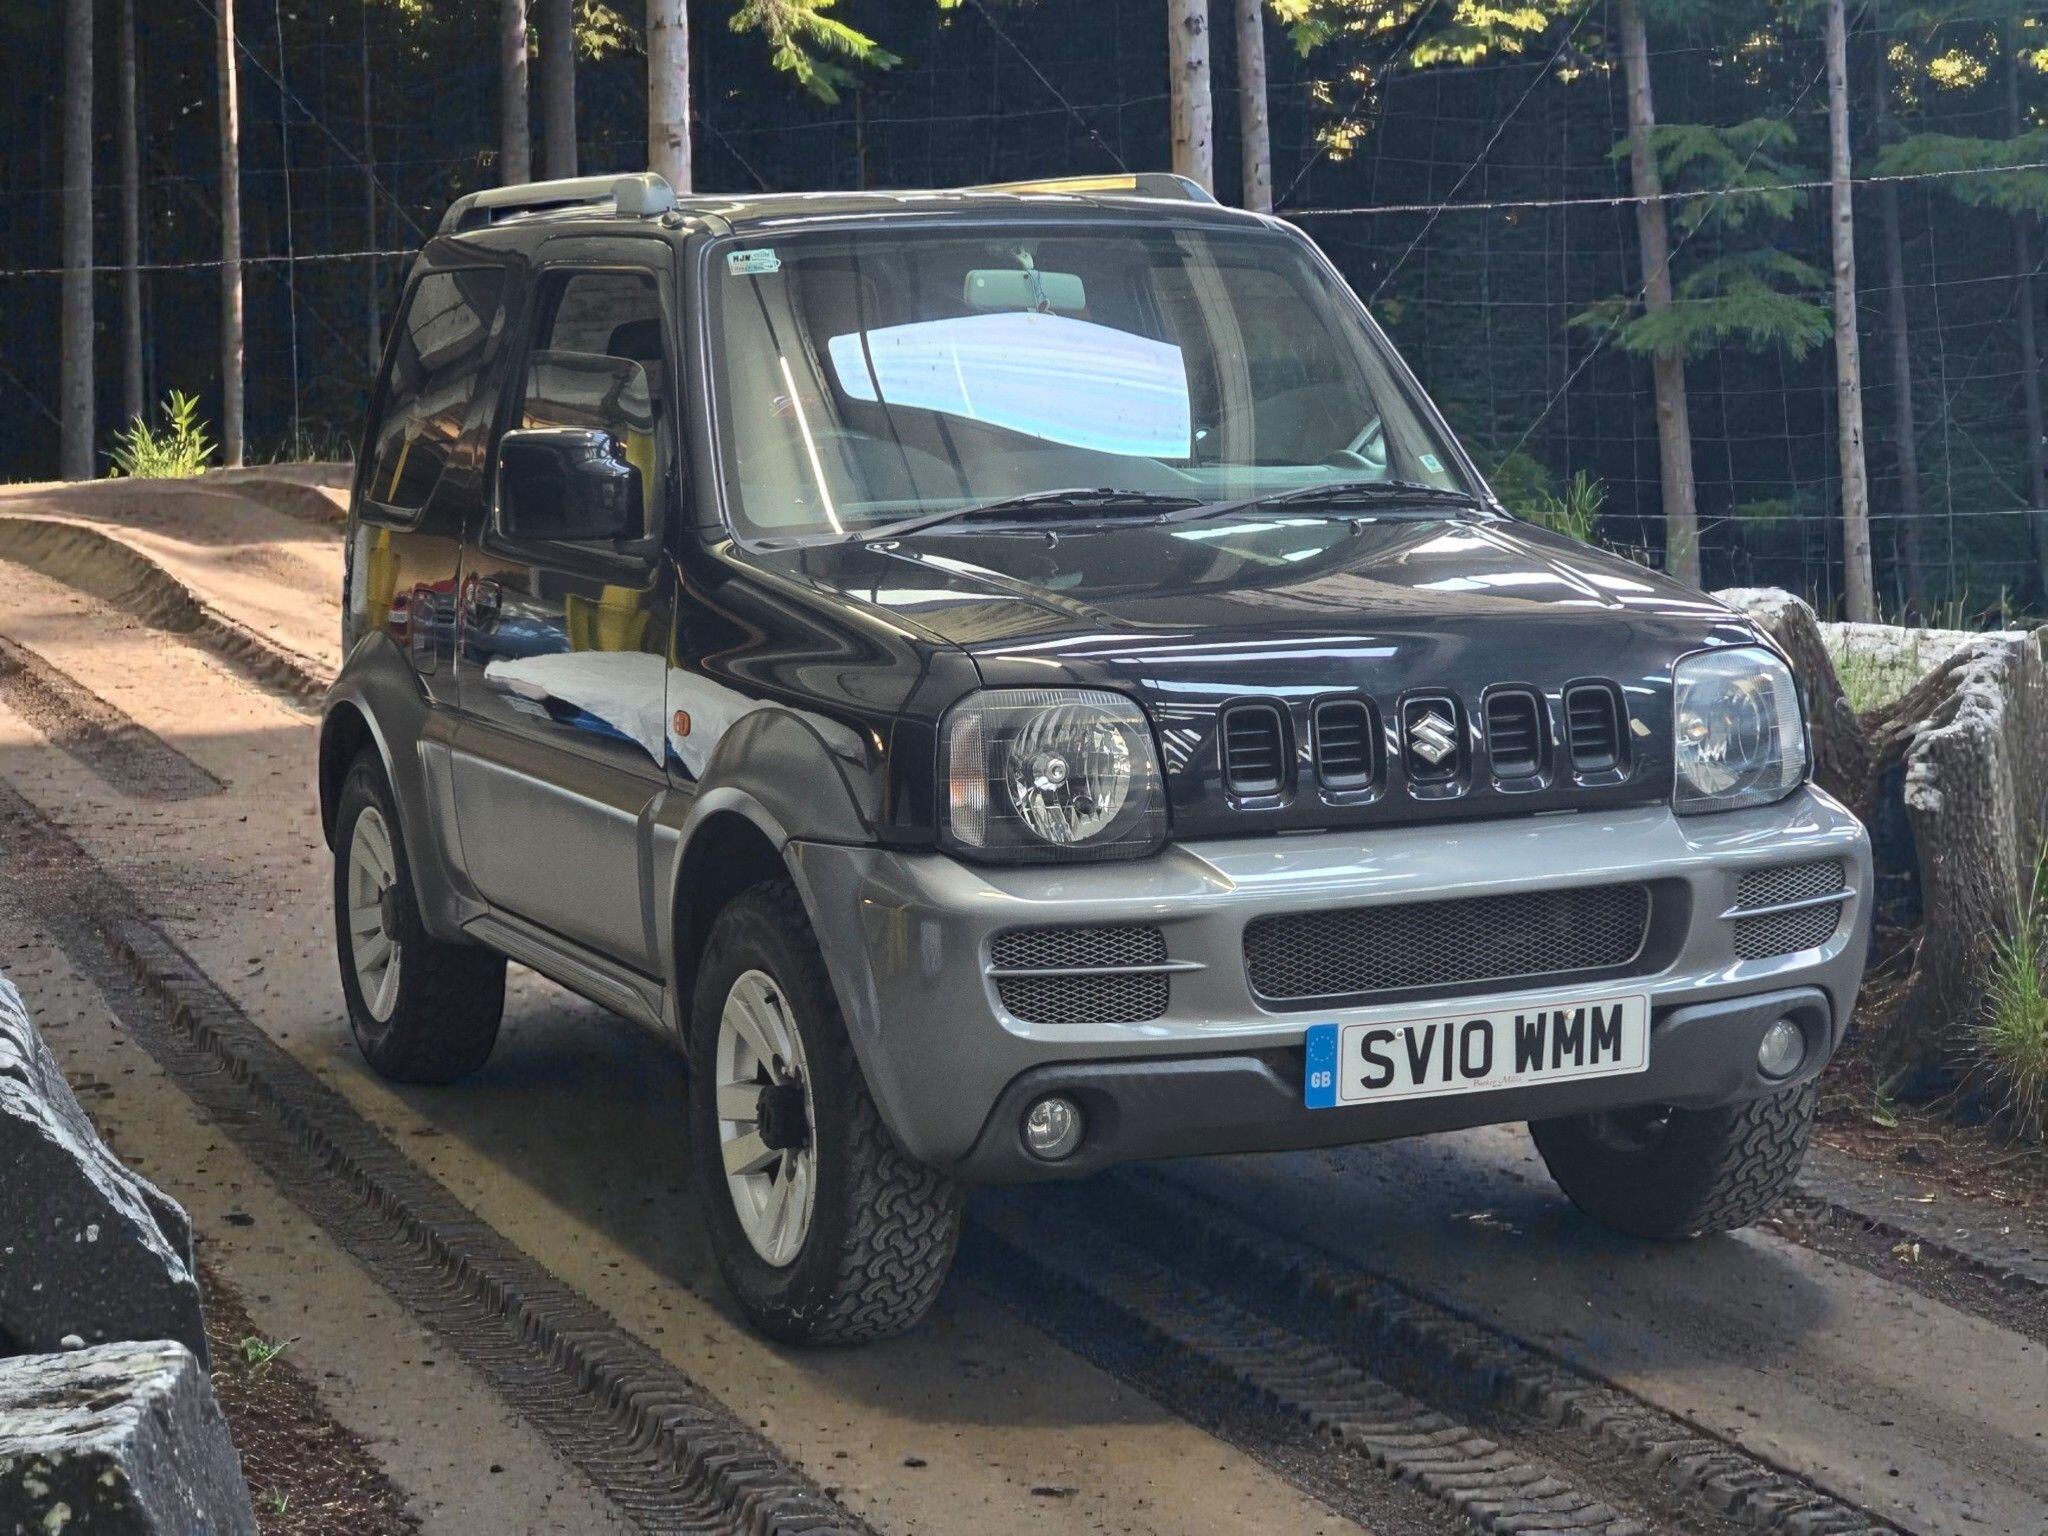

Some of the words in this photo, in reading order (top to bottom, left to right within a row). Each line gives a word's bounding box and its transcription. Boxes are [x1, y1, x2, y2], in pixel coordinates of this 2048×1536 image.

[1361, 1018, 1494, 1090] SV10
[1514, 1003, 1623, 1074] WMM
[1310, 1070, 1331, 1089] GB
